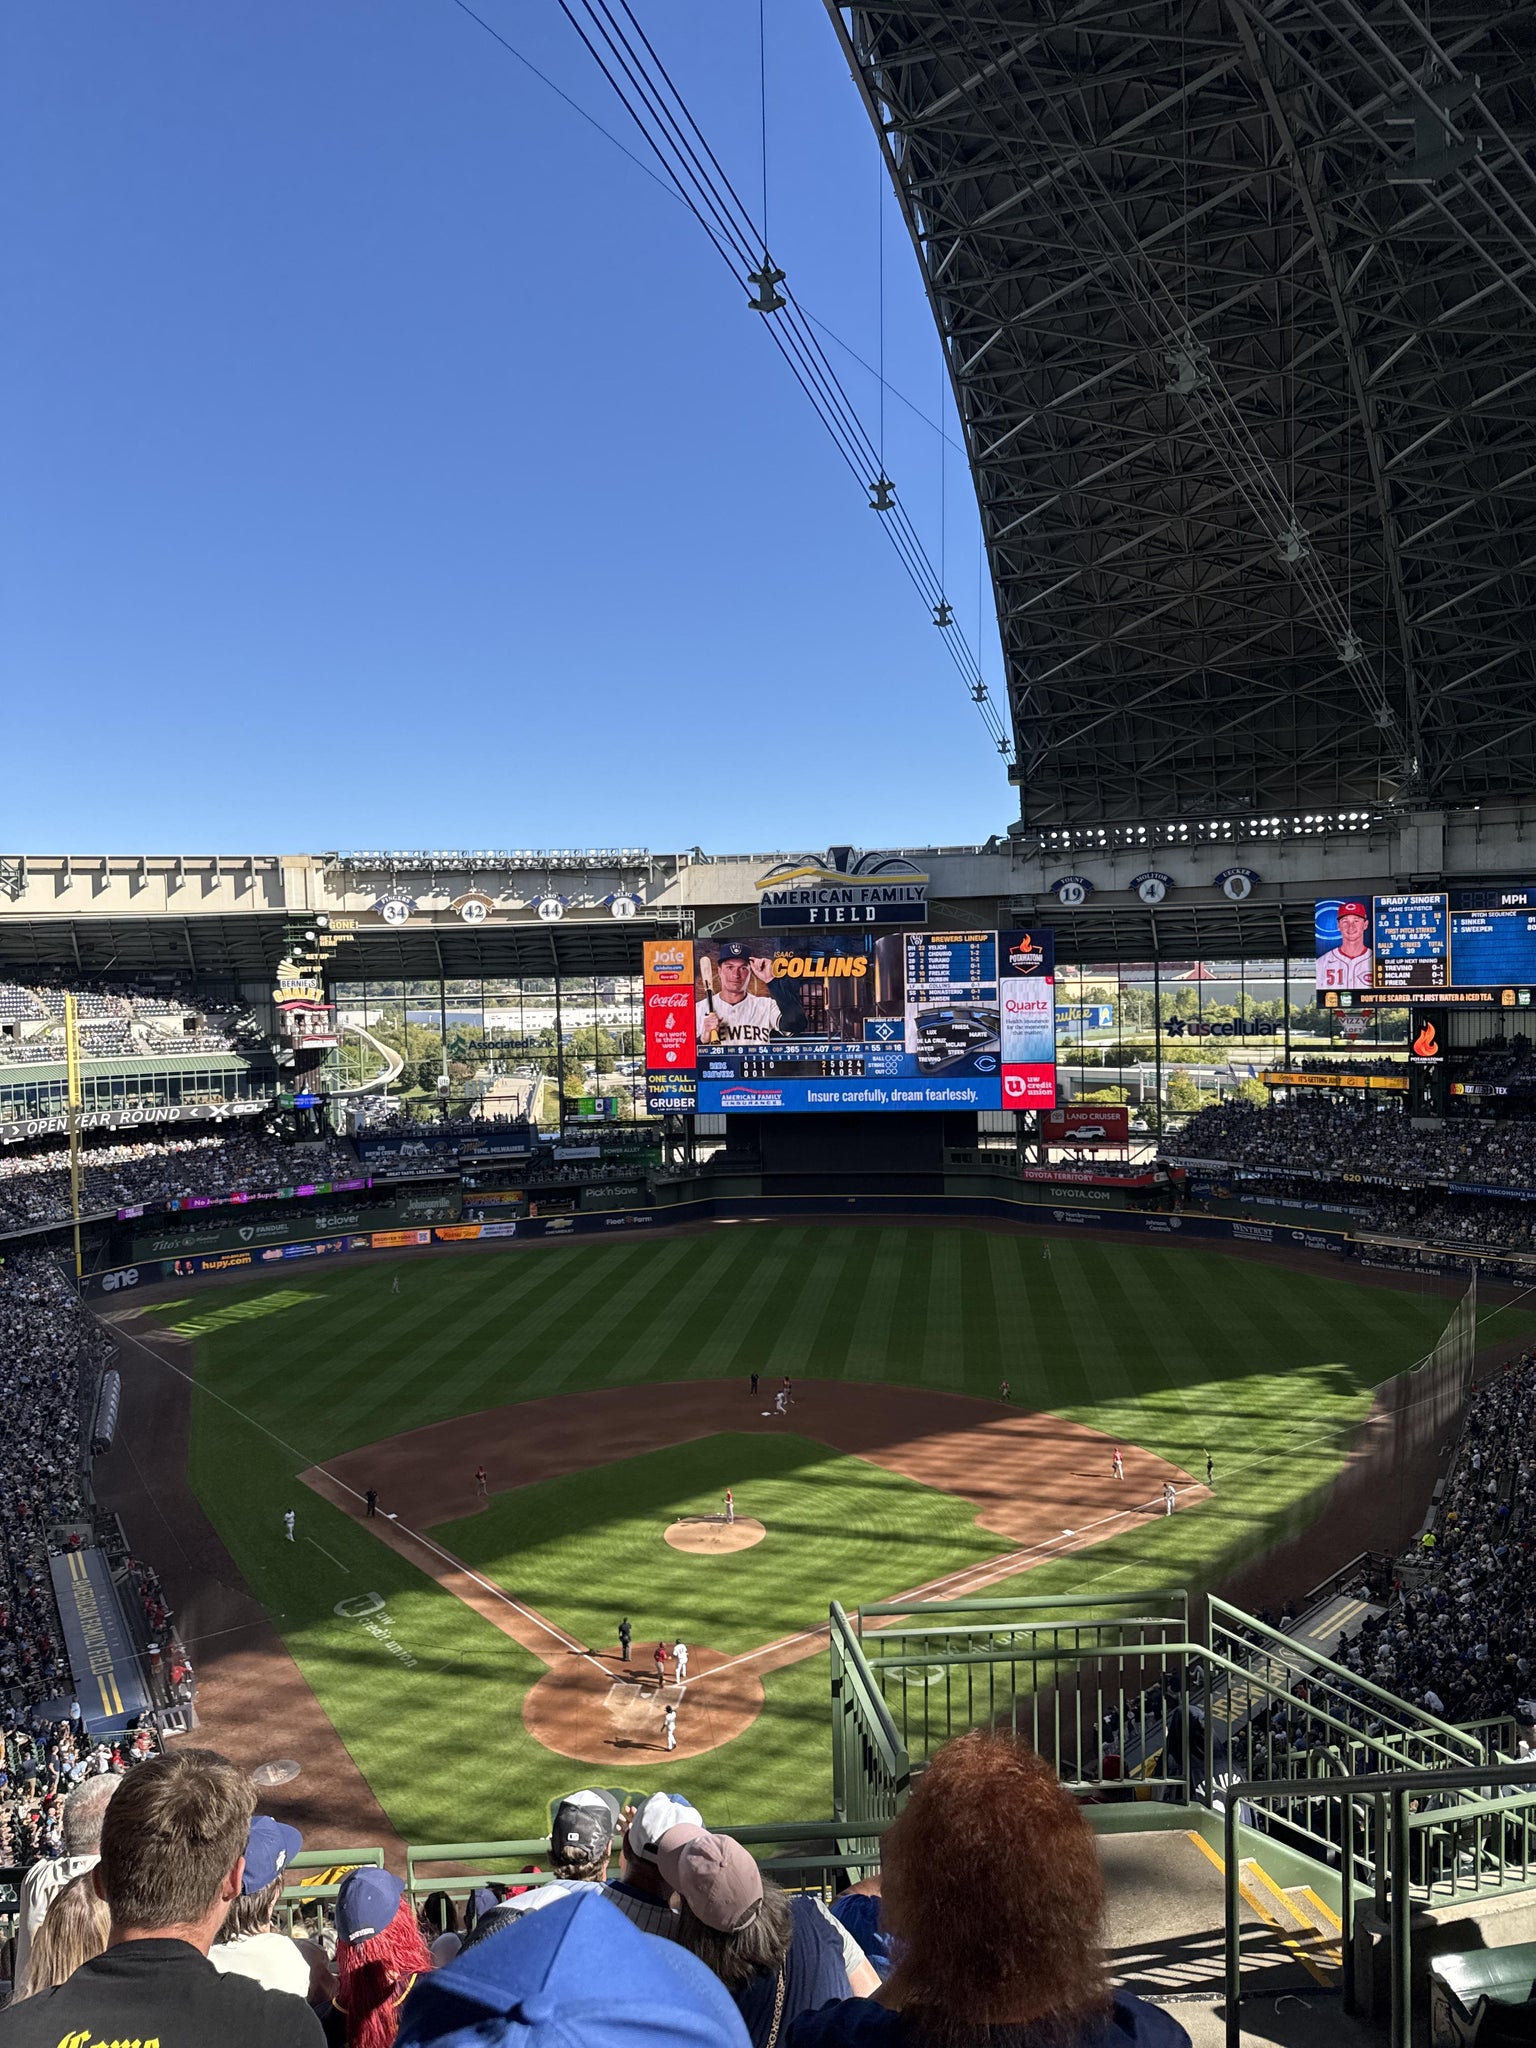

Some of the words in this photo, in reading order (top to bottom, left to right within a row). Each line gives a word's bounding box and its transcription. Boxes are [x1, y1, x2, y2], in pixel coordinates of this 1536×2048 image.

[1060, 876, 1084, 884] YOUNT
[1135, 873, 1168, 883] MOLITOR
[760, 888, 853, 905] AMERICAN
[860, 886, 925, 902] FAMILY
[1063, 887, 1082, 902] 19
[1145, 883, 1157, 898] 4
[381, 894, 411, 904] FINGERS
[1380, 897, 1409, 906] BRADY
[1409, 895, 1441, 904] SINGER
[1502, 894, 1527, 905] MPH
[387, 905, 406, 920] 34
[464, 904, 484, 918] 42
[541, 903, 561, 917] 44
[809, 906, 876, 923] FIELD
[328, 920, 359, 929] GONE!
[930, 935, 964, 943] BREWERS
[964, 934, 988, 942] LINEUP
[653, 947, 685, 963] Joie
[773, 951, 794, 959] ISAAC
[1009, 954, 1043, 963] POTAWATOMI
[772, 956, 868, 979] COLLINS
[1325, 968, 1344, 986] 51
[281, 979, 316, 988] BERNIE'S
[272, 987, 325, 1003] CHALET
[648, 993, 690, 1008] Coca-Cola
[1480, 993, 1494, 1001] TEA.
[1005, 1000, 1047, 1013] Quartz
[1187, 1017, 1282, 1036] uscellular
[1339, 1016, 1368, 1025] VIZZY
[710, 1046, 725, 1055] .261
[738, 1046, 744, 1054] 9
[759, 1046, 769, 1054] 54
[784, 1045, 800, 1054] .365
[813, 1045, 830, 1054] .407
[845, 1044, 861, 1053] .772
[648, 1075, 667, 1083] ONE
[648, 1084, 677, 1093] THAT'S
[678, 1084, 697, 1092] ALL!
[807, 1090, 840, 1103] Insure
[841, 1089, 889, 1104] carefully,
[890, 1088, 924, 1101] dream
[925, 1087, 979, 1103] fearlessly.
[650, 1098, 695, 1108] GRUBER
[27, 1117, 68, 1134] OPEN
[119, 1107, 181, 1123] ROUND
[490, 1145, 525, 1154] MILWAUKEE
[1025, 1171, 1054, 1179] TOYOTA
[1054, 1173, 1093, 1181] TERRITORY
[1342, 1173, 1362, 1182] 620
[1362, 1175, 1392, 1185] WTMJ
[614, 1186, 639, 1196] Save
[1050, 1188, 1110, 1200] TOYOTA.COM
[1448, 1183, 1481, 1193] WINTRUST
[1486, 1188, 1525, 1197] WISCONSIN'S
[194, 1199, 205, 1207] No
[407, 1197, 451, 1211] Johnsonville
[327, 1214, 360, 1227] clover
[633, 1215, 653, 1223] Farm
[255, 1223, 289, 1233] FANDUEL
[1232, 1222, 1274, 1236] WINTRUST
[1305, 1234, 1327, 1243] Aurora
[152, 1239, 181, 1252] Tito's
[1304, 1240, 1326, 1250] Health
[1326, 1243, 1343, 1252] Care
[201, 1256, 252, 1271] hupy.com
[1414, 1267, 1441, 1276] BULLPEN
[71, 1579, 101, 1620] AMERICAN
[375, 1611, 396, 1625] uw
[79, 1617, 109, 1649] FAMILY
[358, 1617, 392, 1641] credit
[384, 1640, 418, 1667] union
[87, 1647, 114, 1675] FIELD
